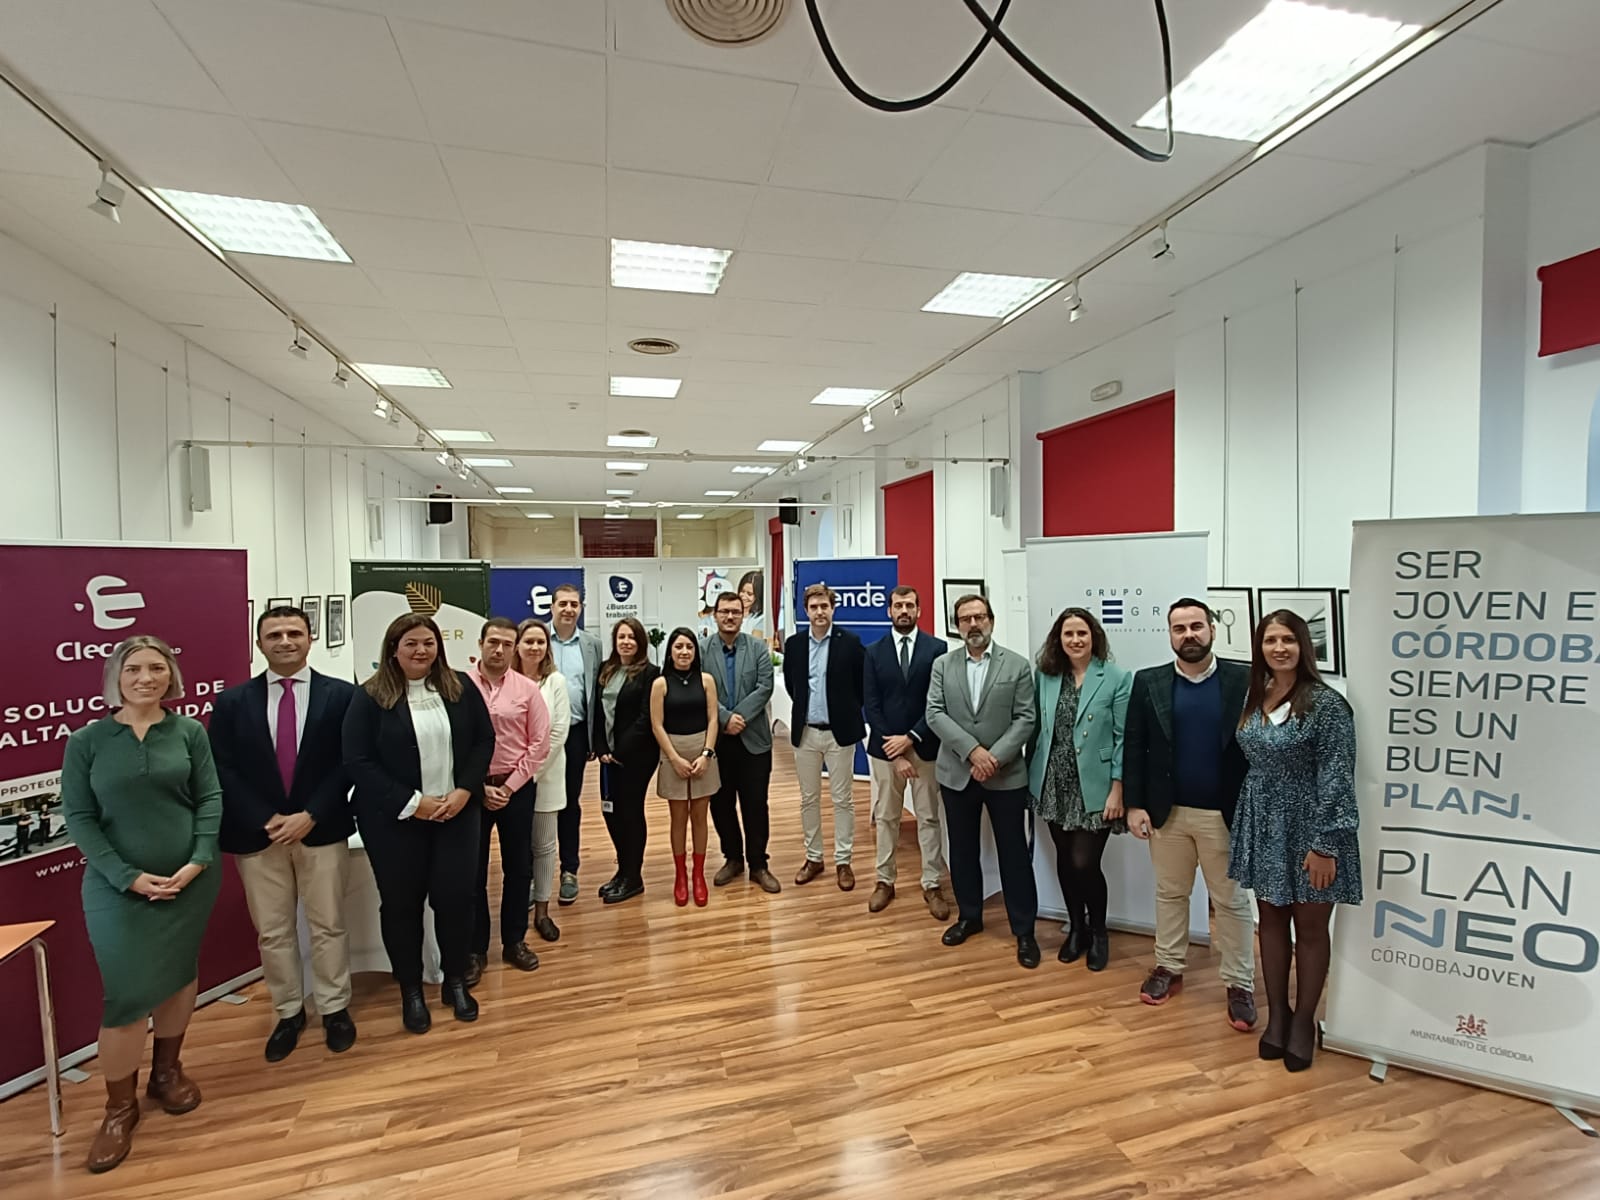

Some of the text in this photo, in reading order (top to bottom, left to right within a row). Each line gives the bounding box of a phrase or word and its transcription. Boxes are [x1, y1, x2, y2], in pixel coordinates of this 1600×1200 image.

[1395, 550, 1482, 580] SER
[1085, 588, 1143, 597] GRUPO
[1393, 591, 1599, 621] JOVEN E
[196, 680, 225, 696] DE
[1388, 670, 1588, 704] SIEMPRE
[0, 723, 71, 749] ALTA
[1388, 708, 1518, 741] ES UN
[1386, 746, 1502, 779] BUEN
[0, 776, 62, 797] PROTEGE
[1376, 849, 1572, 916] PLAN
[1373, 900, 1600, 974] NEO
[1410, 1029, 1475, 1050] AYUNTAMIENTO
[1475, 1043, 1488, 1053] DE
